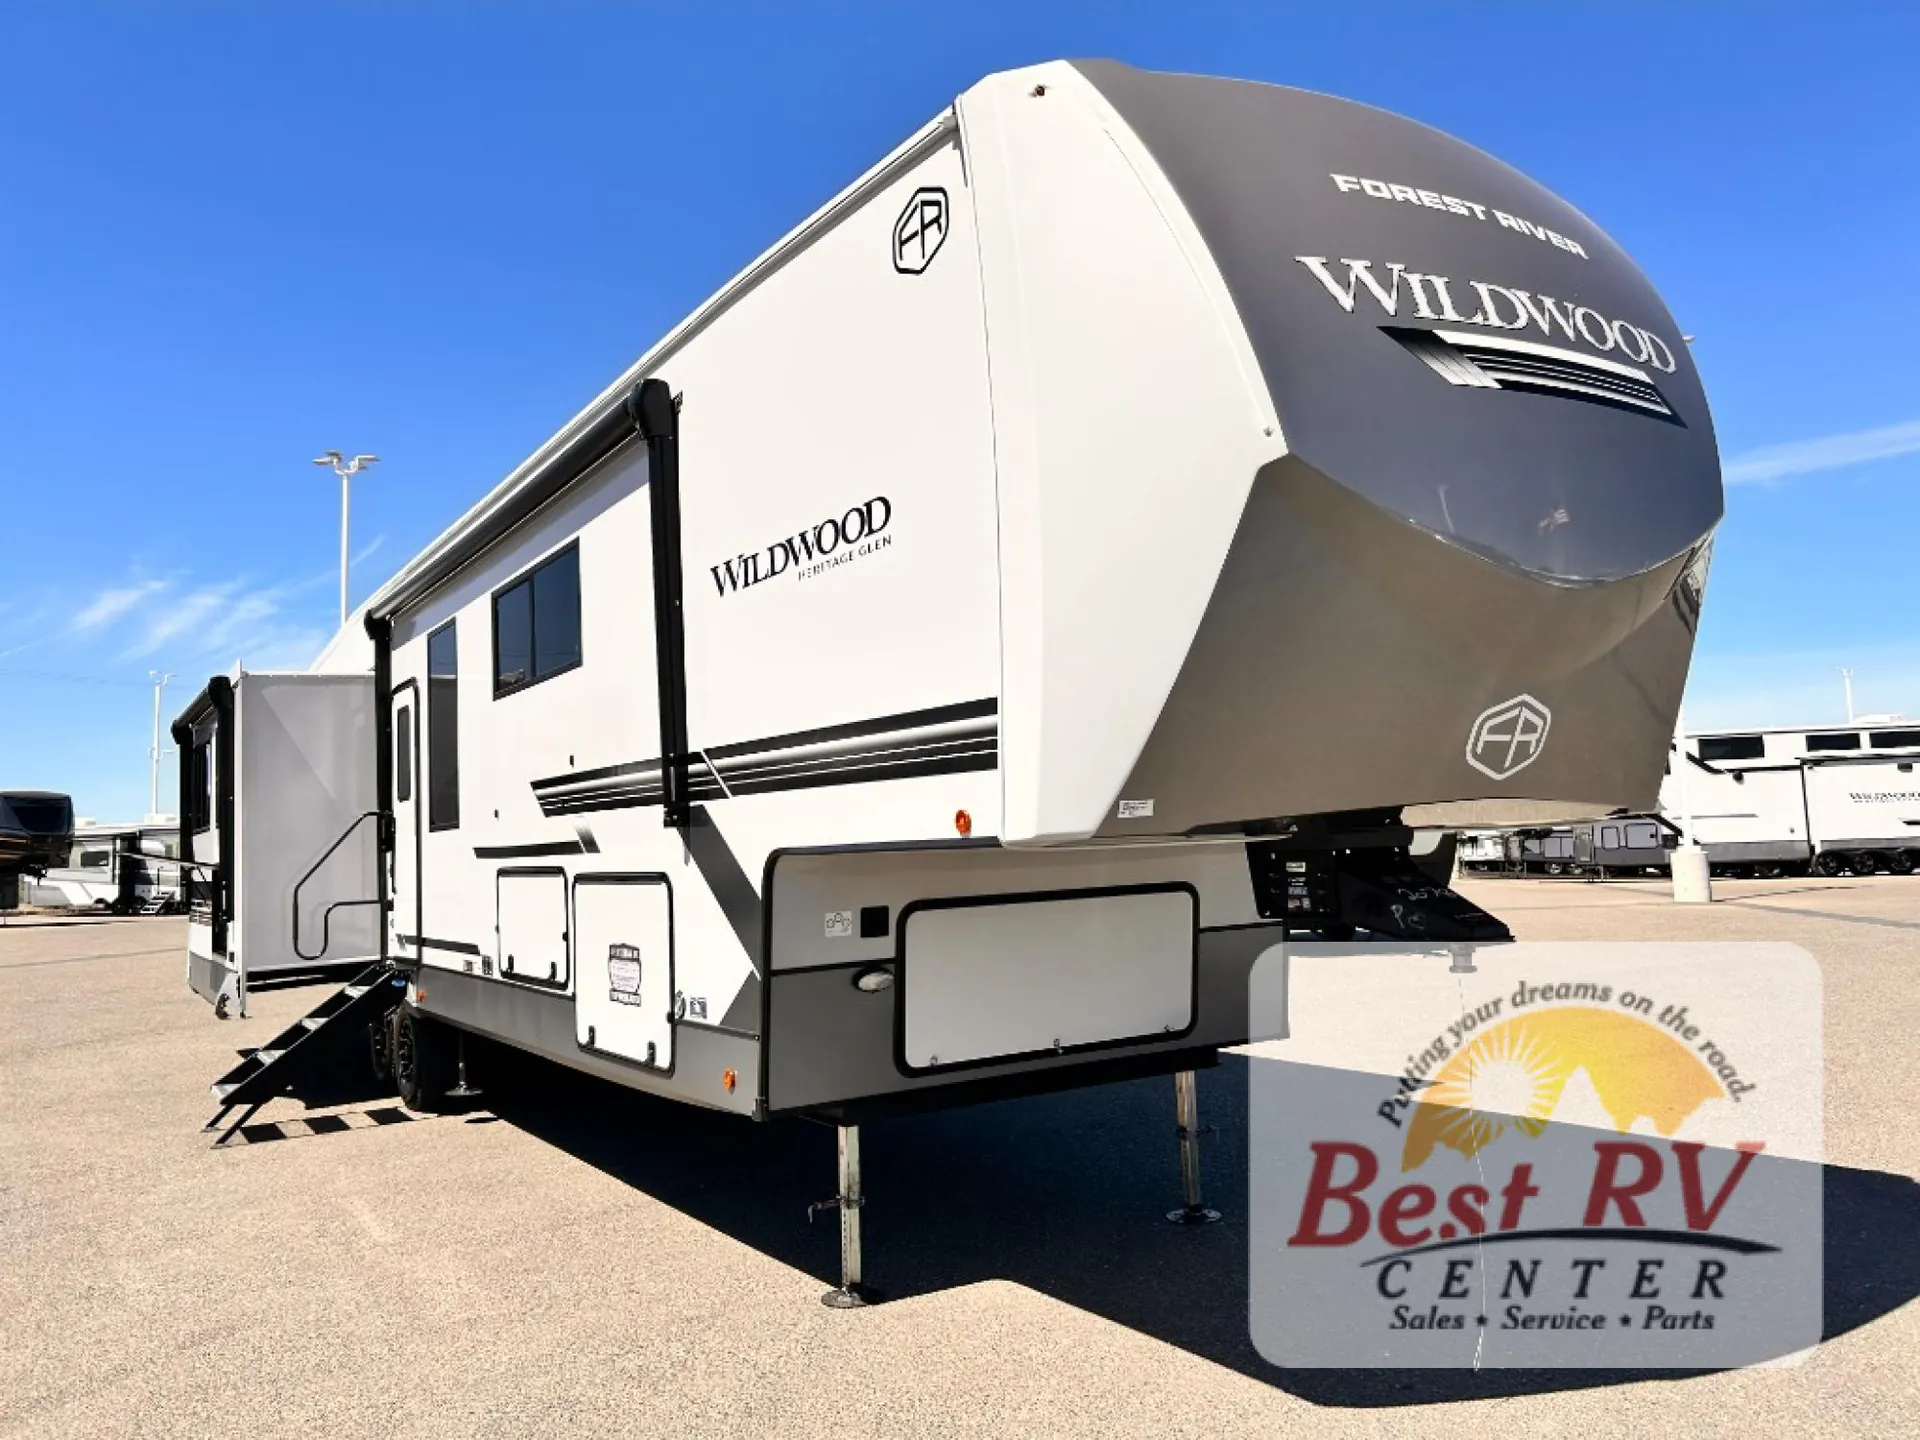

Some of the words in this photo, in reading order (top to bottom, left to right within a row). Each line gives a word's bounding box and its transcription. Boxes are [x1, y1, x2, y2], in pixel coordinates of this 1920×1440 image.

[1330, 173, 1486, 220] FOREST
[1493, 209, 1588, 259] RIVER
[1295, 256, 1676, 374] WILDWOOD
[710, 496, 891, 598] WILDWOOD
[798, 550, 854, 582] HERITAGE
[858, 534, 892, 557] GLEN
